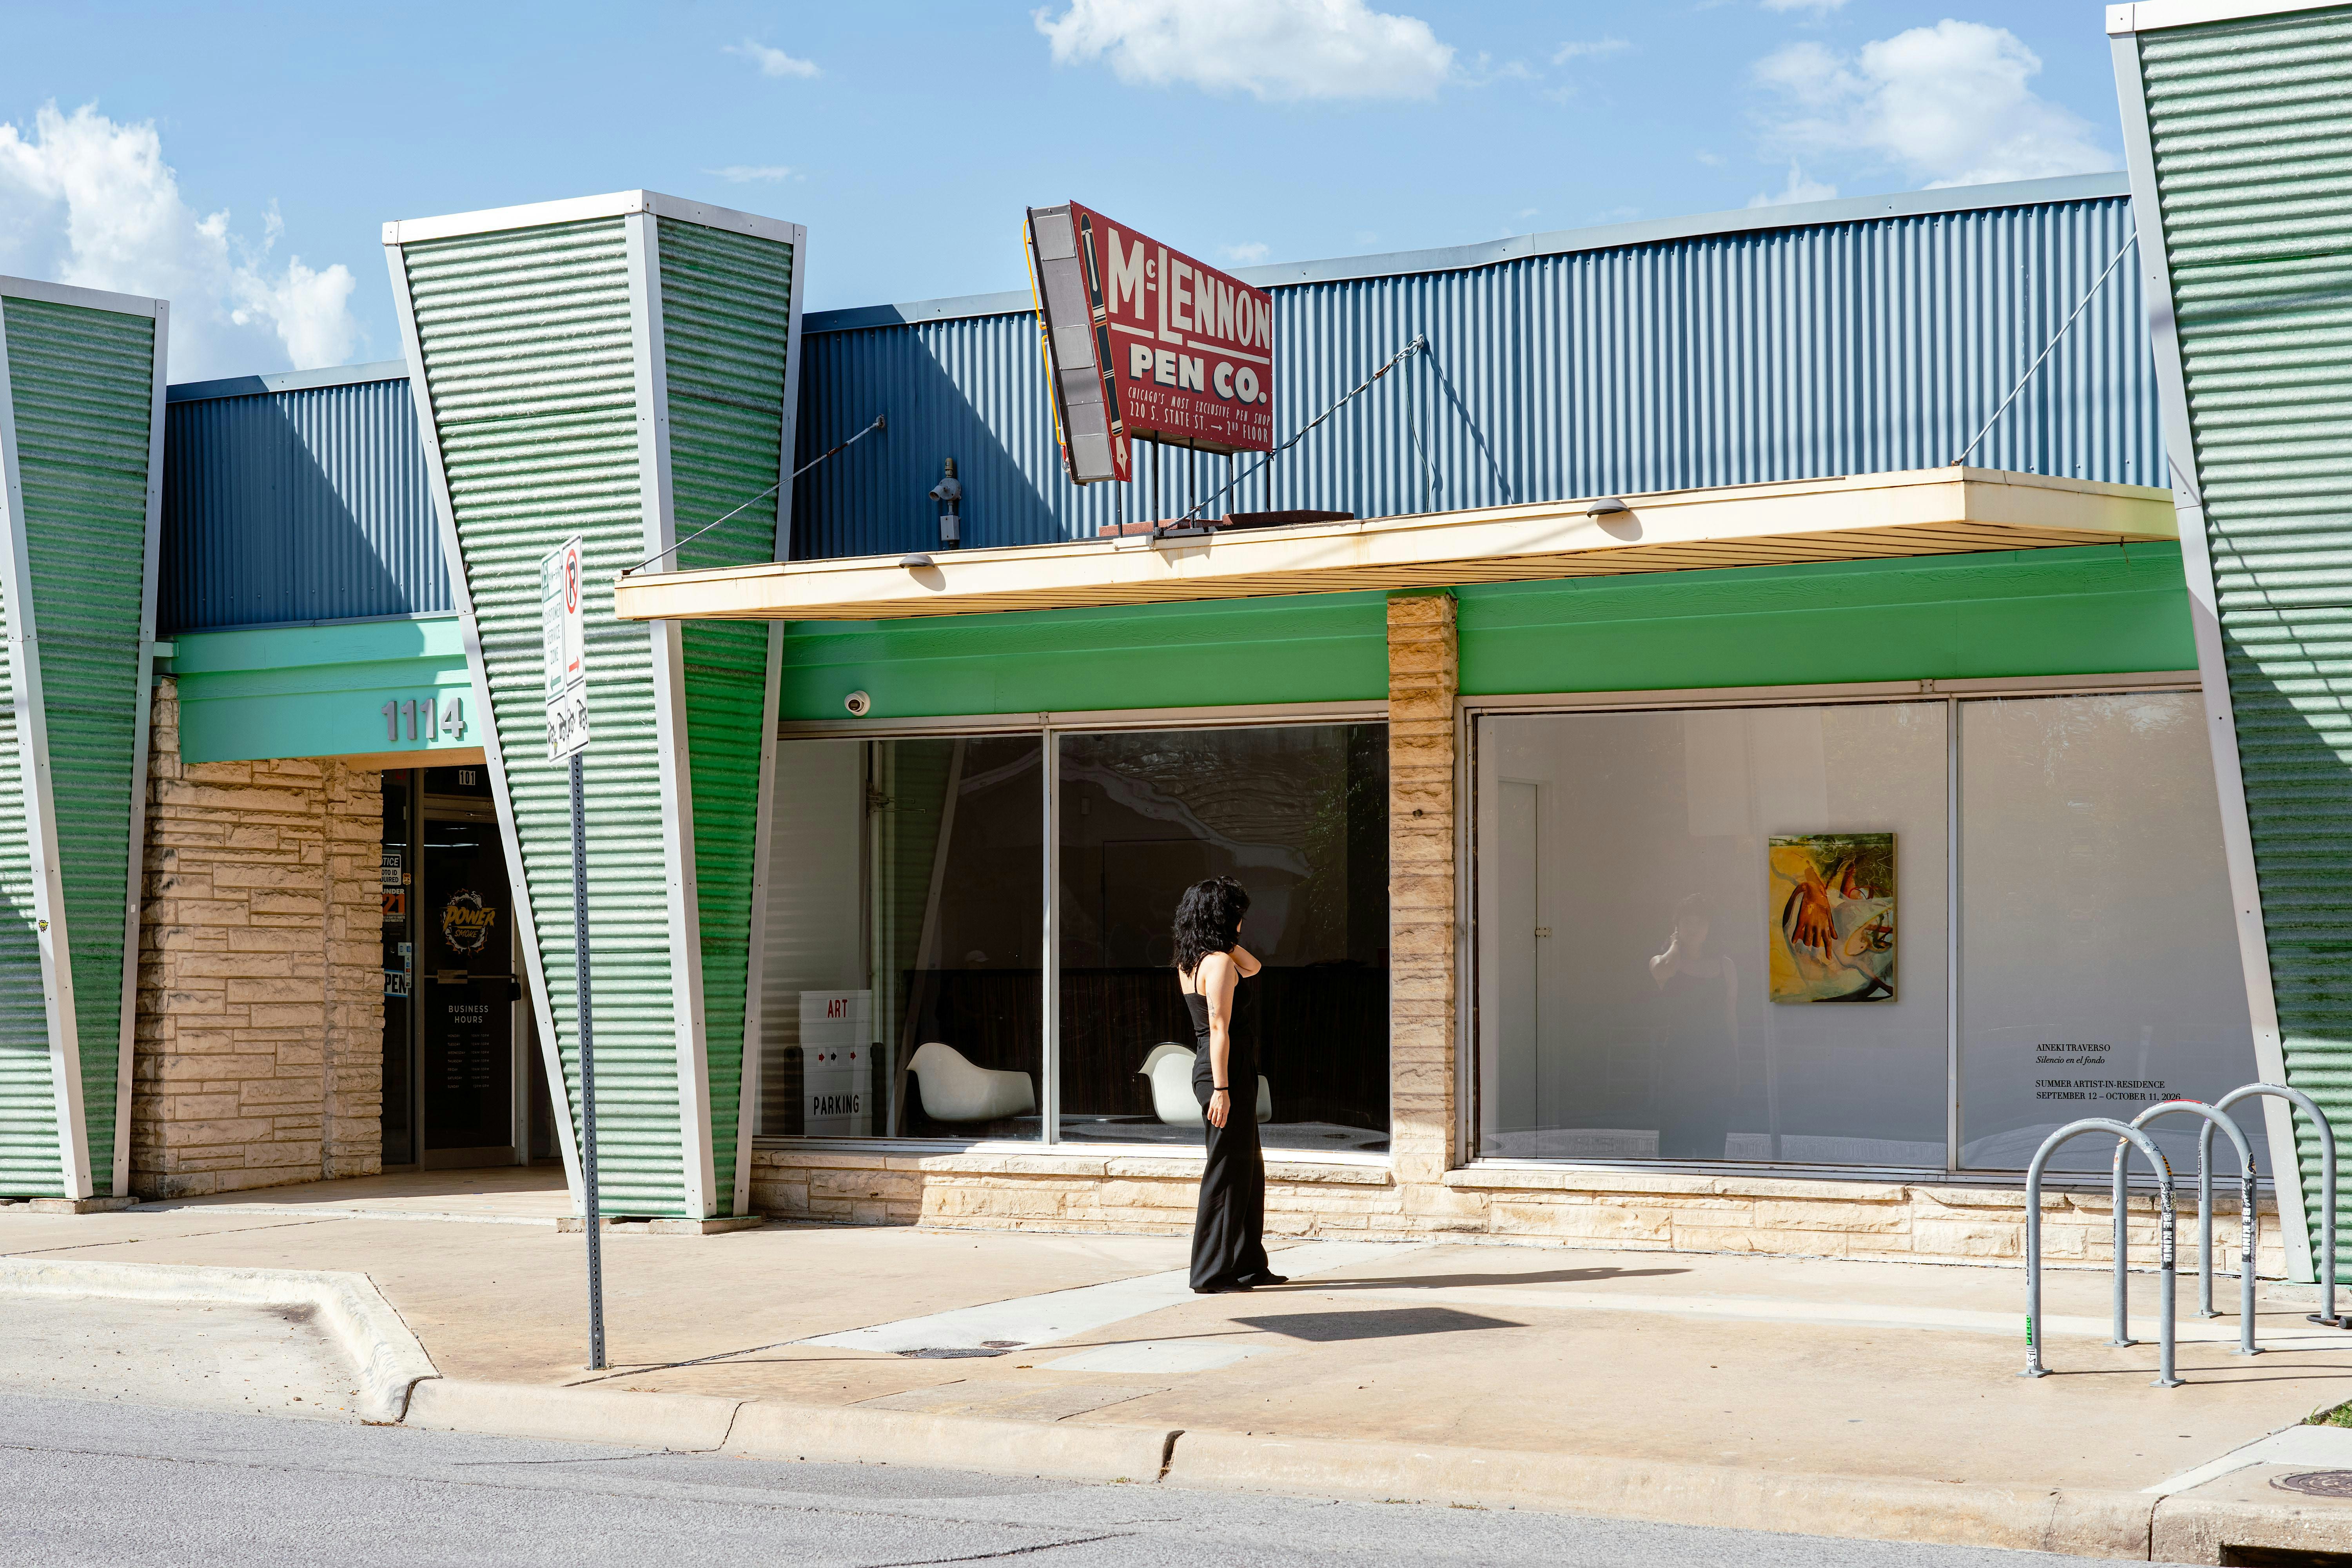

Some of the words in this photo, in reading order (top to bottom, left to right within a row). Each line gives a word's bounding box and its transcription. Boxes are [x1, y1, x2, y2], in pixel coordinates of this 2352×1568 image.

[1130, 343, 1204, 392] PEN
[1213, 361, 1267, 405] CO.
[1128, 387, 1165, 405] CHICAGO'S
[1171, 396, 1189, 410] MOST
[1196, 401, 1230, 418] EXCLUSIVE
[1236, 409, 1248, 422] PEN
[1254, 413, 1270, 426] SHOP
[1130, 401, 1145, 418] 220
[1151, 405, 1159, 421] S.
[1165, 408, 1189, 428] STATE
[1194, 414, 1208, 431] ST.
[1227, 421, 1238, 436] 2ND
[1243, 424, 1268, 443] FLOOR
[544, 602, 561, 626] CUSTOMER
[547, 624, 560, 645] SERVICE
[550, 646, 559, 665] ZONE
[381, 698, 463, 740] 1114
[460, 771, 474, 784] 101
[383, 857, 399, 866] TICE
[382, 894, 405, 914] 21
[443, 906, 495, 931] POWER
[455, 929, 478, 938] SMOKE
[384, 973, 406, 993] PEN
[828, 999, 848, 1018] ART
[2082, 1057, 2105, 1065] fondo
[814, 1094, 859, 1115] PARKING
[2149, 1093, 2159, 1102] 11,
[2163, 1212, 2172, 1228] BE
[2242, 1208, 2251, 1223] BE
[2163, 1231, 2172, 1262] KIND
[2242, 1225, 2251, 1255] KIND
